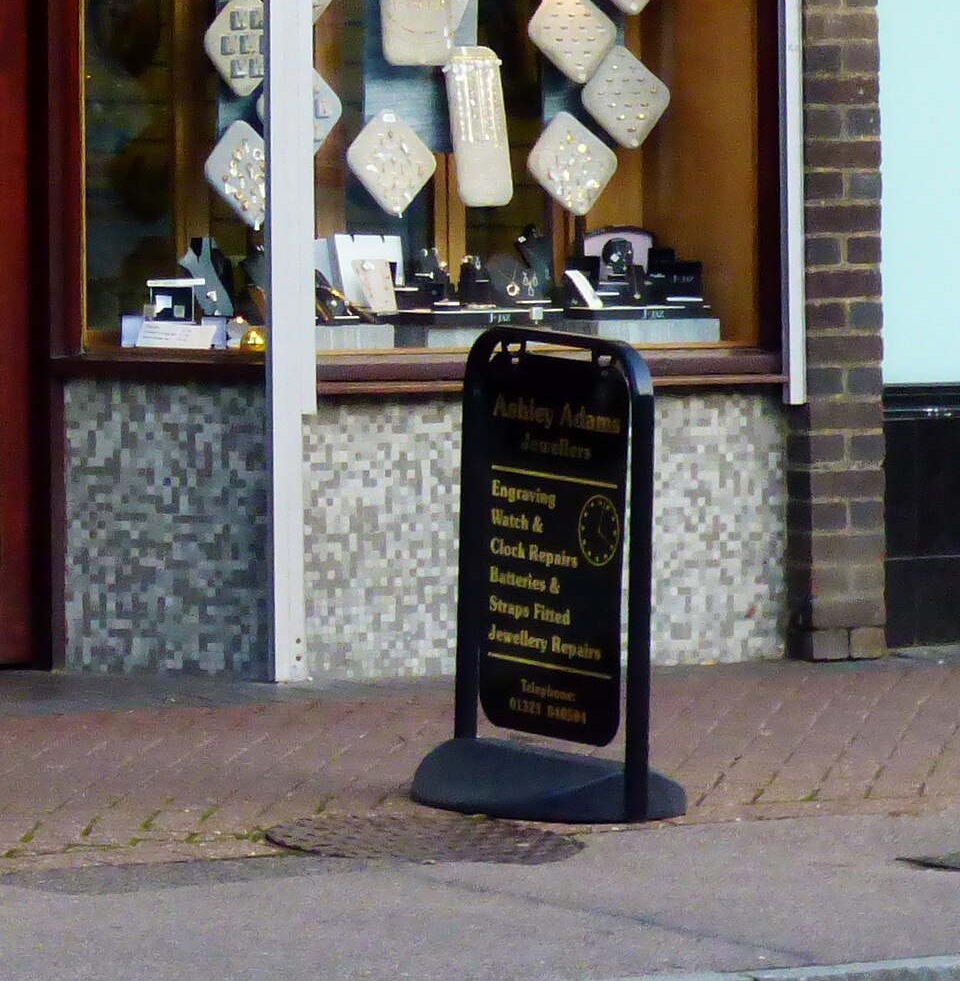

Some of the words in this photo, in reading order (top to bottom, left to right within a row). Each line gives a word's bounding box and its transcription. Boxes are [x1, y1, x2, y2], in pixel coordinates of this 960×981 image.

[493, 393, 553, 429] Ashley
[560, 402, 621, 434] Adams
[491, 479, 557, 510] Engraving
[490, 507, 529, 531] Watch
[532, 515, 545, 534] &
[489, 537, 526, 559] Clock
[528, 544, 579, 569] Repairs
[489, 564, 547, 593] Batteries
[549, 576, 561, 595] &
[488, 594, 530, 620] Straps
[533, 602, 572, 626] Fitted
[488, 623, 549, 653] Jewellery
[551, 635, 603, 660] Repairs
